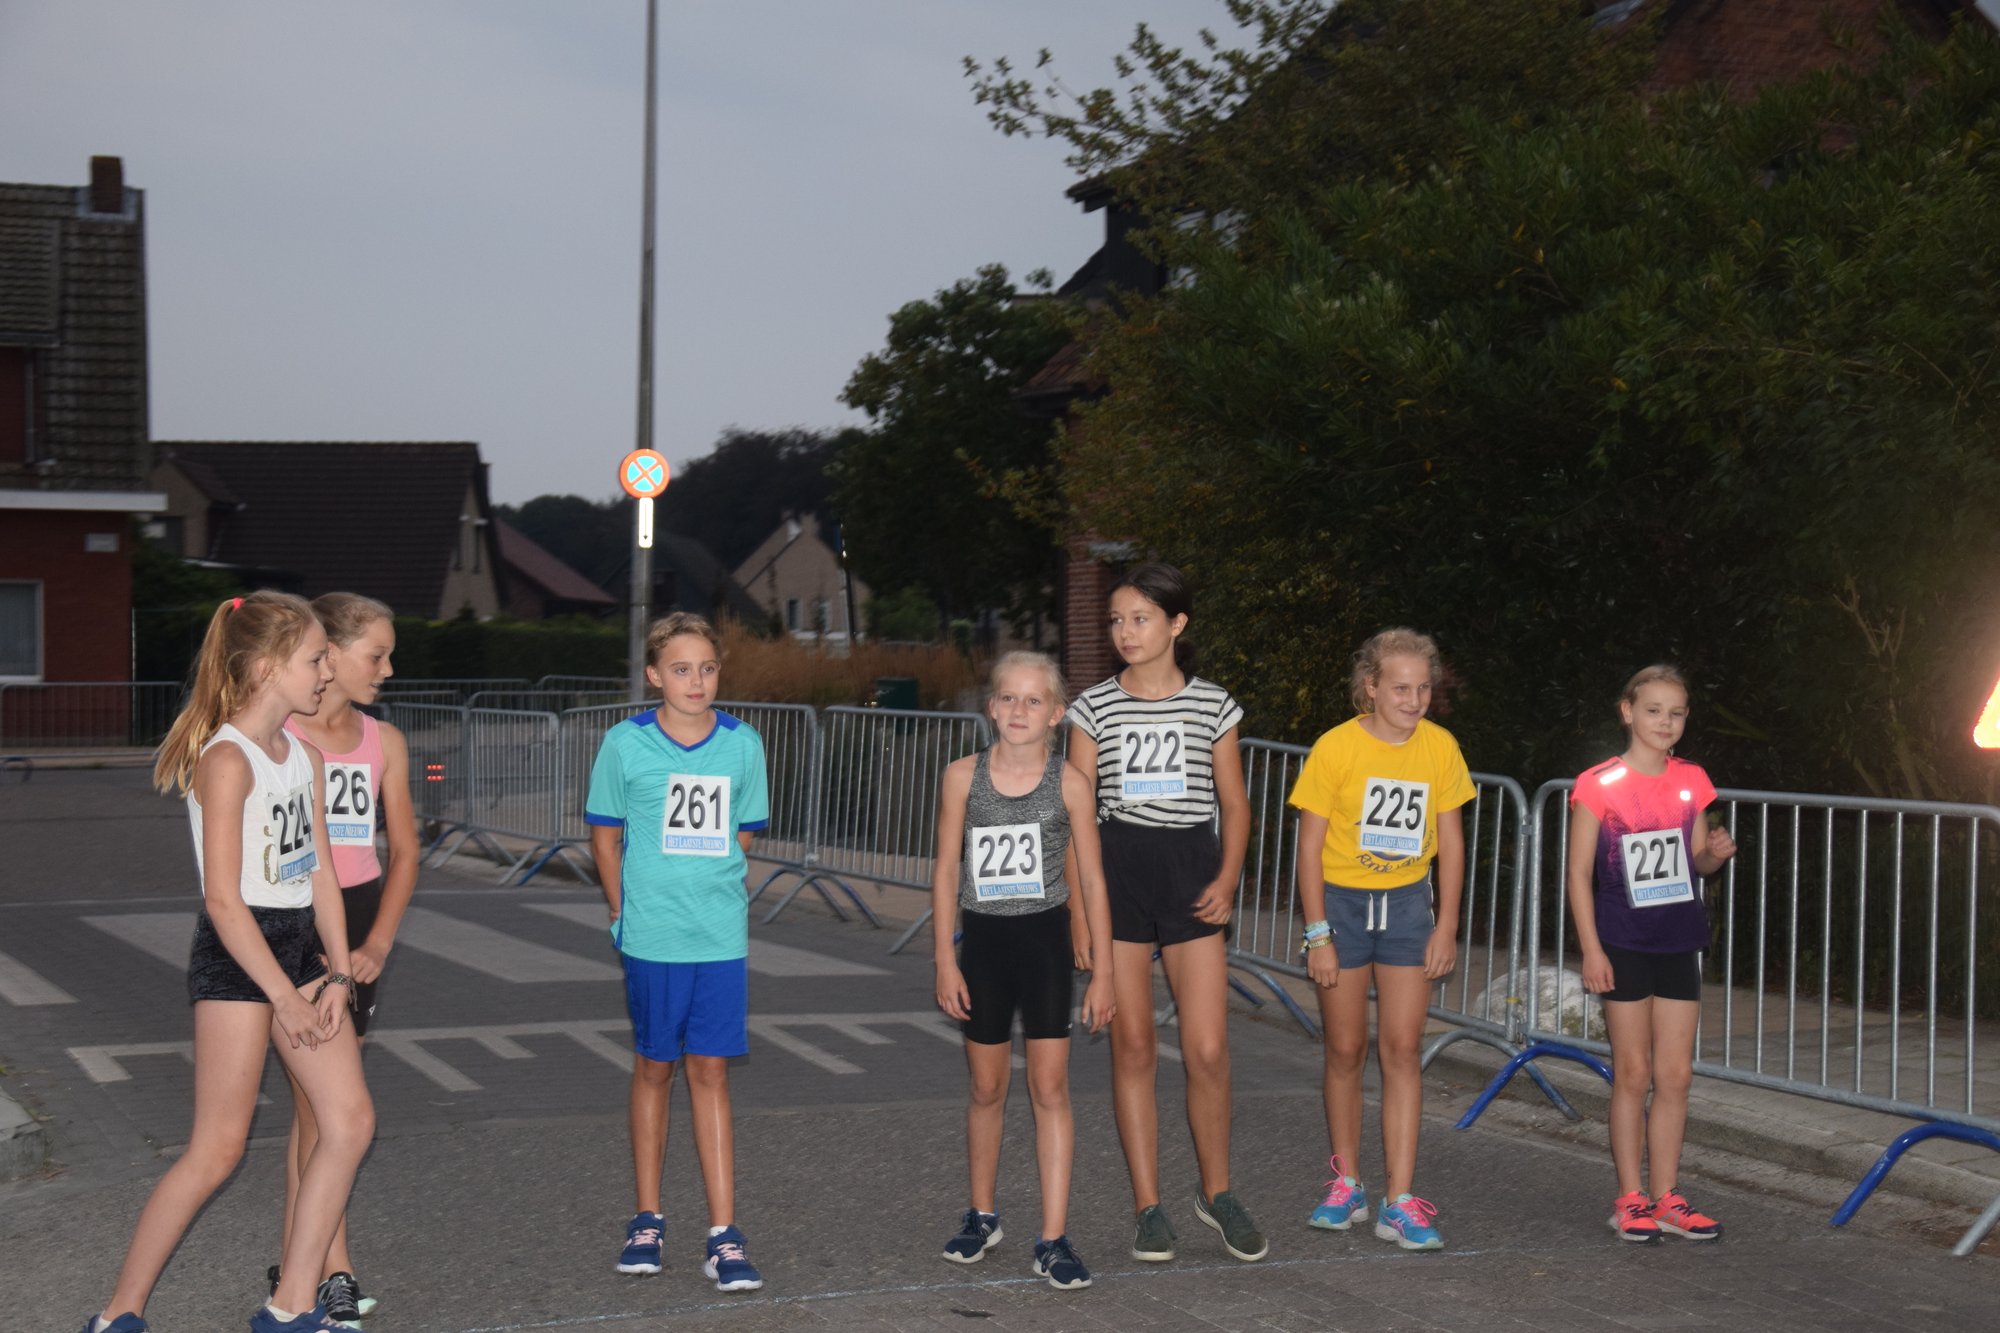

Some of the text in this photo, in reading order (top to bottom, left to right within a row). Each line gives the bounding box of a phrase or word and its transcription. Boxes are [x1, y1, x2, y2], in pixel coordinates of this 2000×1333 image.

[1126, 730, 1182, 773] 222
[325, 769, 370, 816] 26
[668, 783, 722, 830] 261
[1126, 782, 1137, 793] HET
[1137, 782, 1160, 793] LAATSTE
[1366, 784, 1423, 830] 225
[273, 793, 311, 855] 224
[667, 835, 678, 847] HET
[679, 835, 702, 849] LAATSTE
[1364, 833, 1375, 845] HET
[1375, 834, 1397, 848] LAATSTE
[979, 832, 1036, 877] 223
[1356, 853, 1393, 872] Ronde
[1631, 836, 1680, 881] 227
[982, 885, 993, 896] HET
[993, 884, 1017, 895] LAATSTE
[1636, 888, 1647, 900] HET
